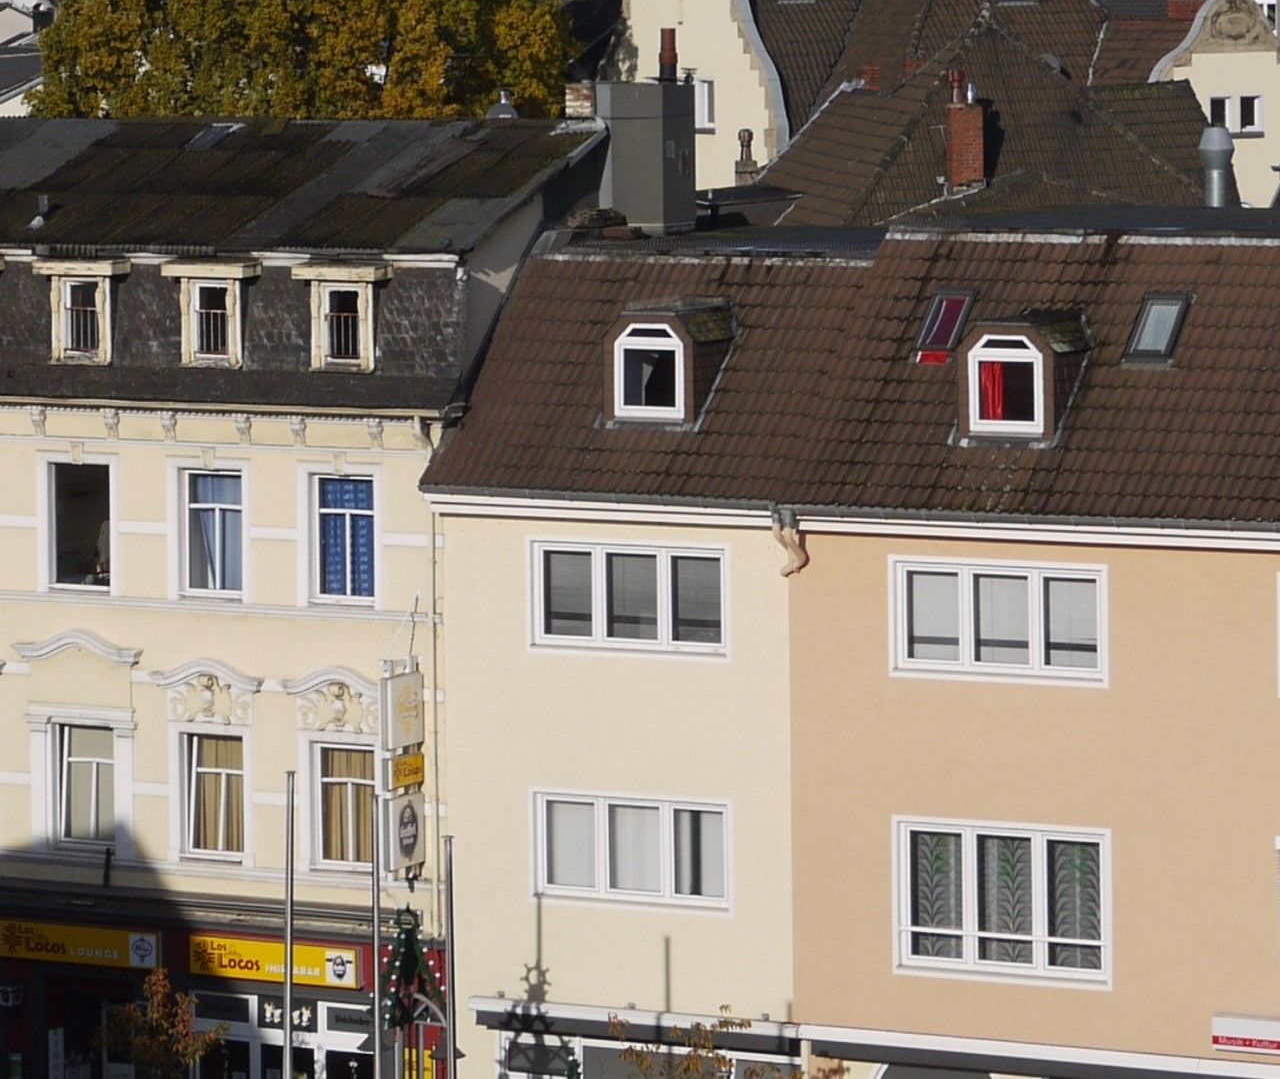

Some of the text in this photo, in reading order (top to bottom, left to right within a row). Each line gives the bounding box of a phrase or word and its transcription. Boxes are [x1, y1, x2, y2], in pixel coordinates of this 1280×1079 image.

[70, 946, 119, 959] LOUNGE
[1218, 1036, 1244, 1046] Musik
[1252, 1039, 1278, 1049] Kultur
